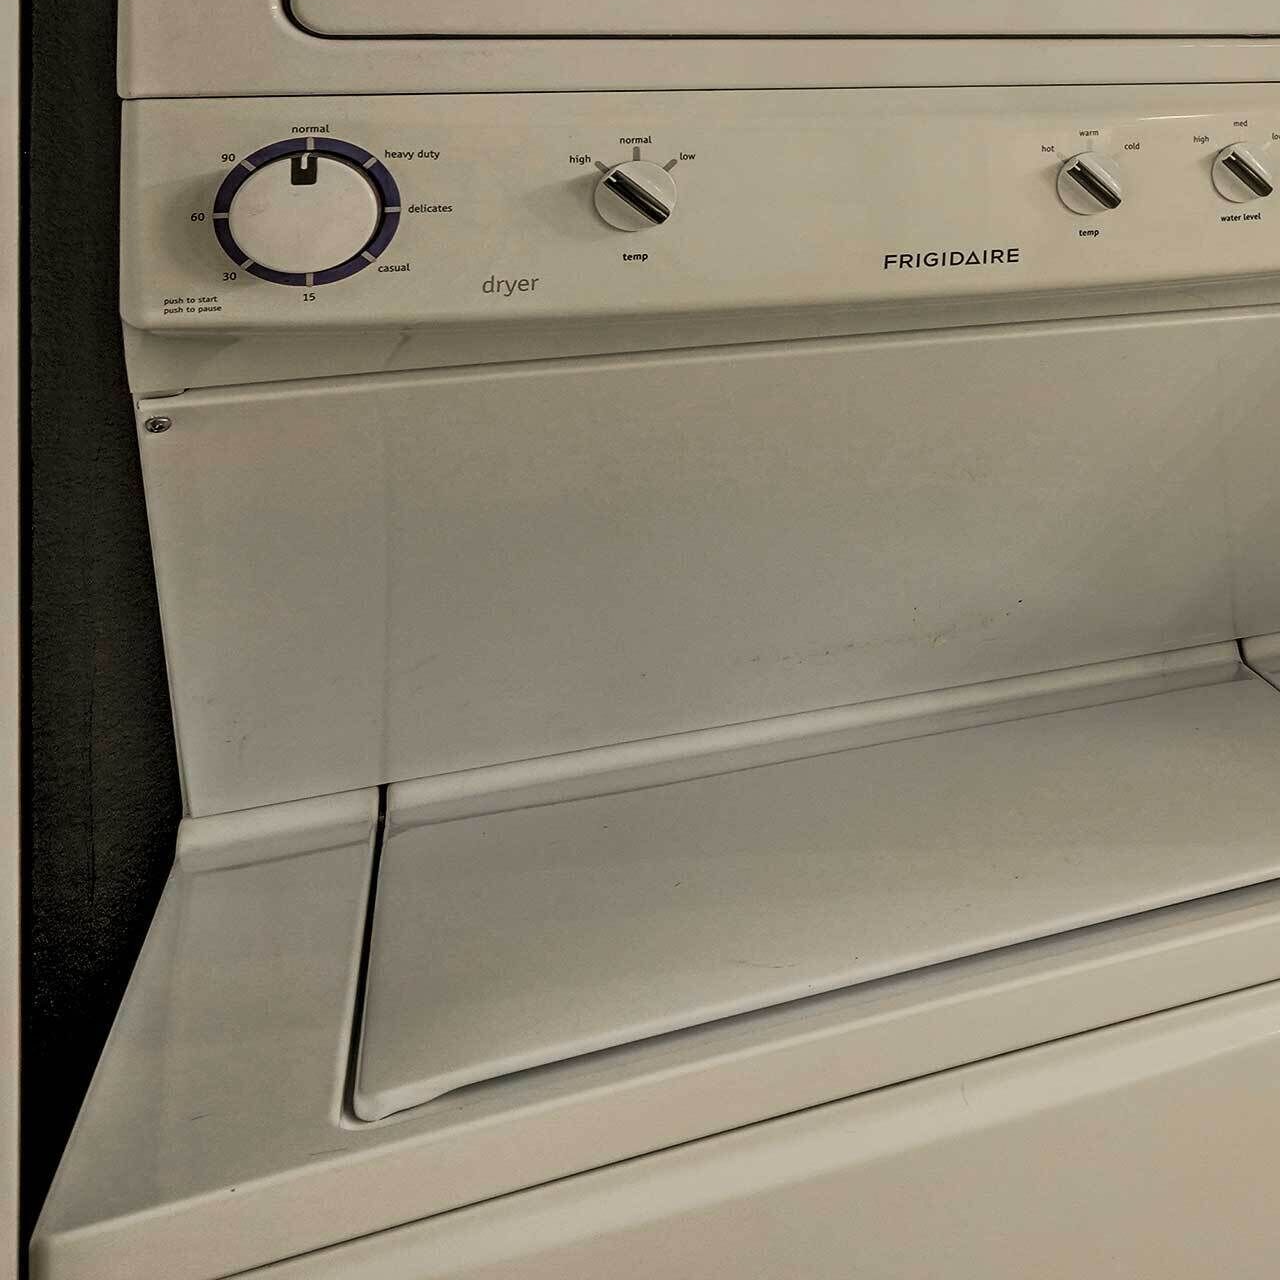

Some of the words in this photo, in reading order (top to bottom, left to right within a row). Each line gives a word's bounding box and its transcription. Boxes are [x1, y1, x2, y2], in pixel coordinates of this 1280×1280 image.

[291, 124, 330, 134] normal
[1233, 120, 1248, 128] med
[1079, 128, 1099, 137] warm
[619, 135, 652, 144] normal
[1193, 135, 1210, 145] high
[1041, 144, 1055, 153] hot
[1124, 142, 1140, 150] cold
[221, 153, 236, 163] 90
[384, 149, 415, 161] heavy
[417, 149, 440, 161] duty
[569, 154, 592, 165] high
[679, 151, 696, 161] low
[408, 203, 453, 214] delicates
[190, 212, 205, 222] 60
[1220, 213, 1242, 222] water
[1243, 212, 1262, 221] level
[1078, 228, 1100, 238] temp
[622, 252, 649, 263] temp
[883, 248, 1020, 270] FRIGIDAIRE
[377, 262, 411, 273] casual
[222, 271, 237, 281] 30
[481, 275, 540, 297] dryer
[163, 298, 184, 306] push
[198, 296, 218, 304] start
[302, 292, 316, 302] 15
[163, 307, 184, 315] push
[198, 306, 222, 314] pause
